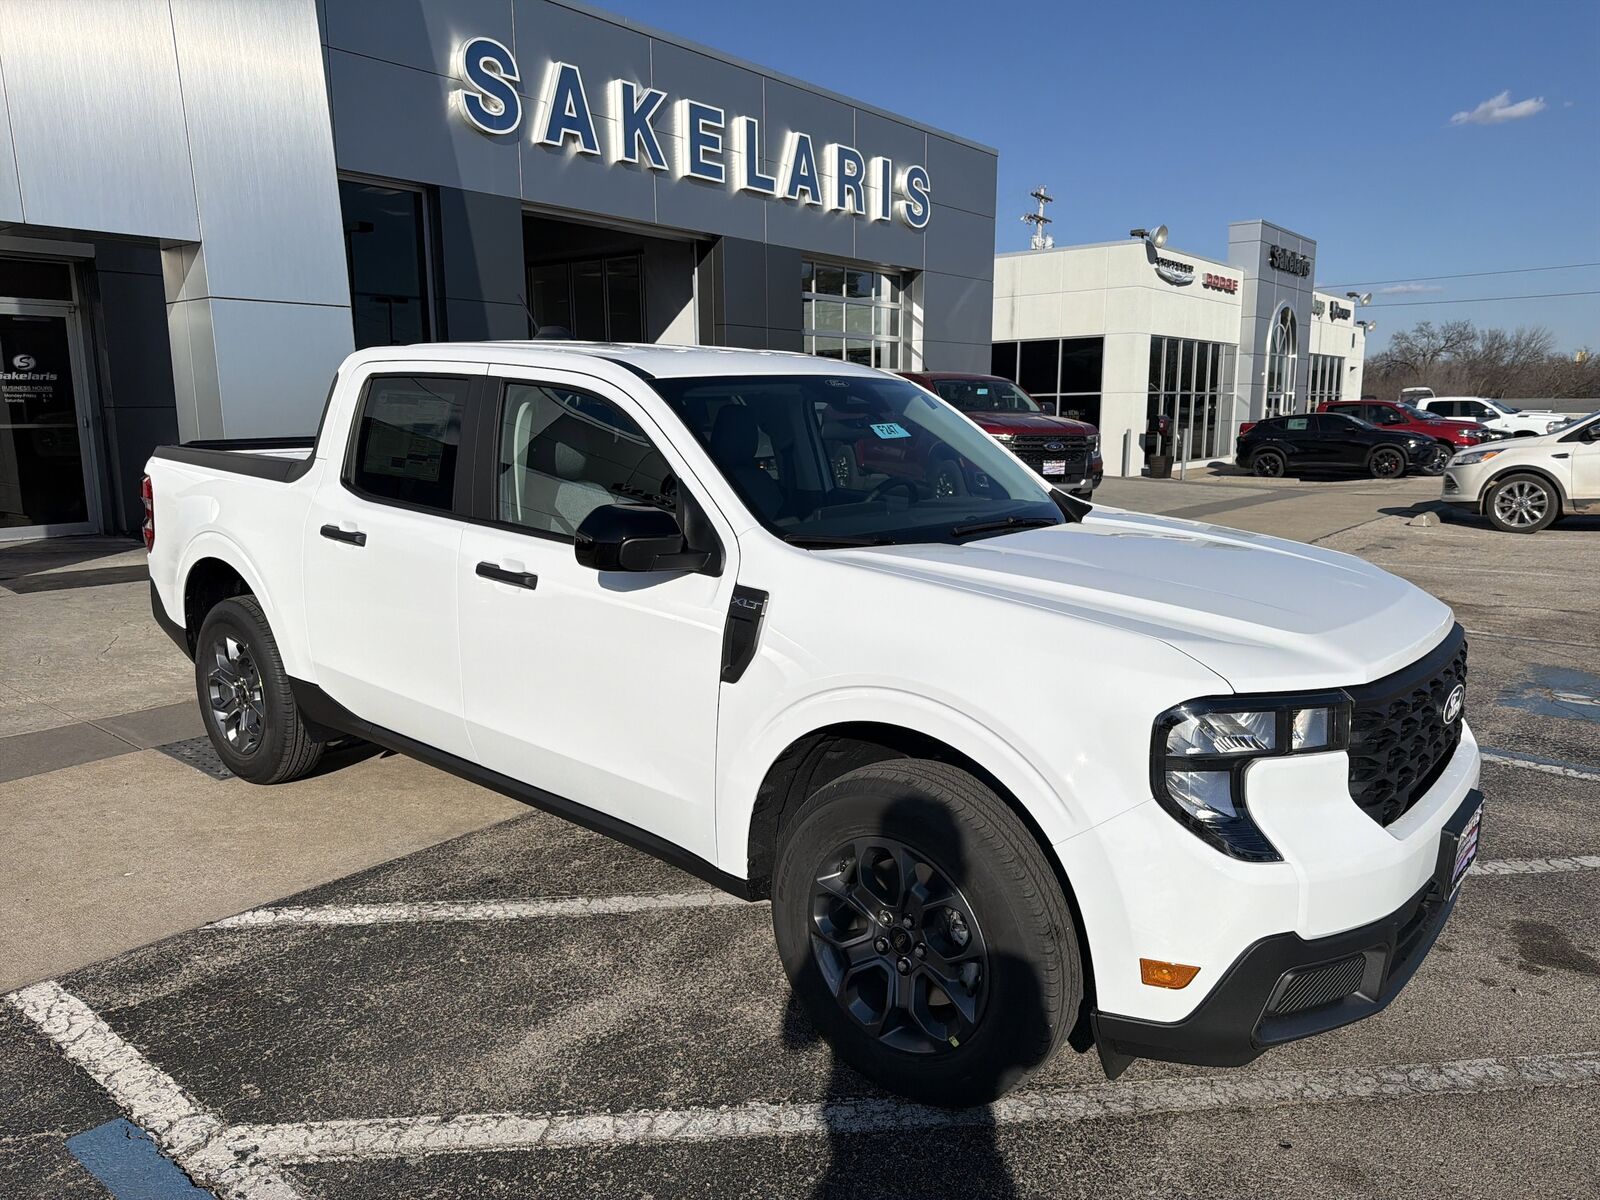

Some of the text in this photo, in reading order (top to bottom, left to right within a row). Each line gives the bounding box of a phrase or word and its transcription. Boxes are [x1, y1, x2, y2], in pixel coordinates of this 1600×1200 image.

[453, 36, 932, 229] SAKELARIS
[1204, 272, 1238, 291] DODGE
[877, 425, 900, 436] F247
[731, 595, 763, 610] XLT
